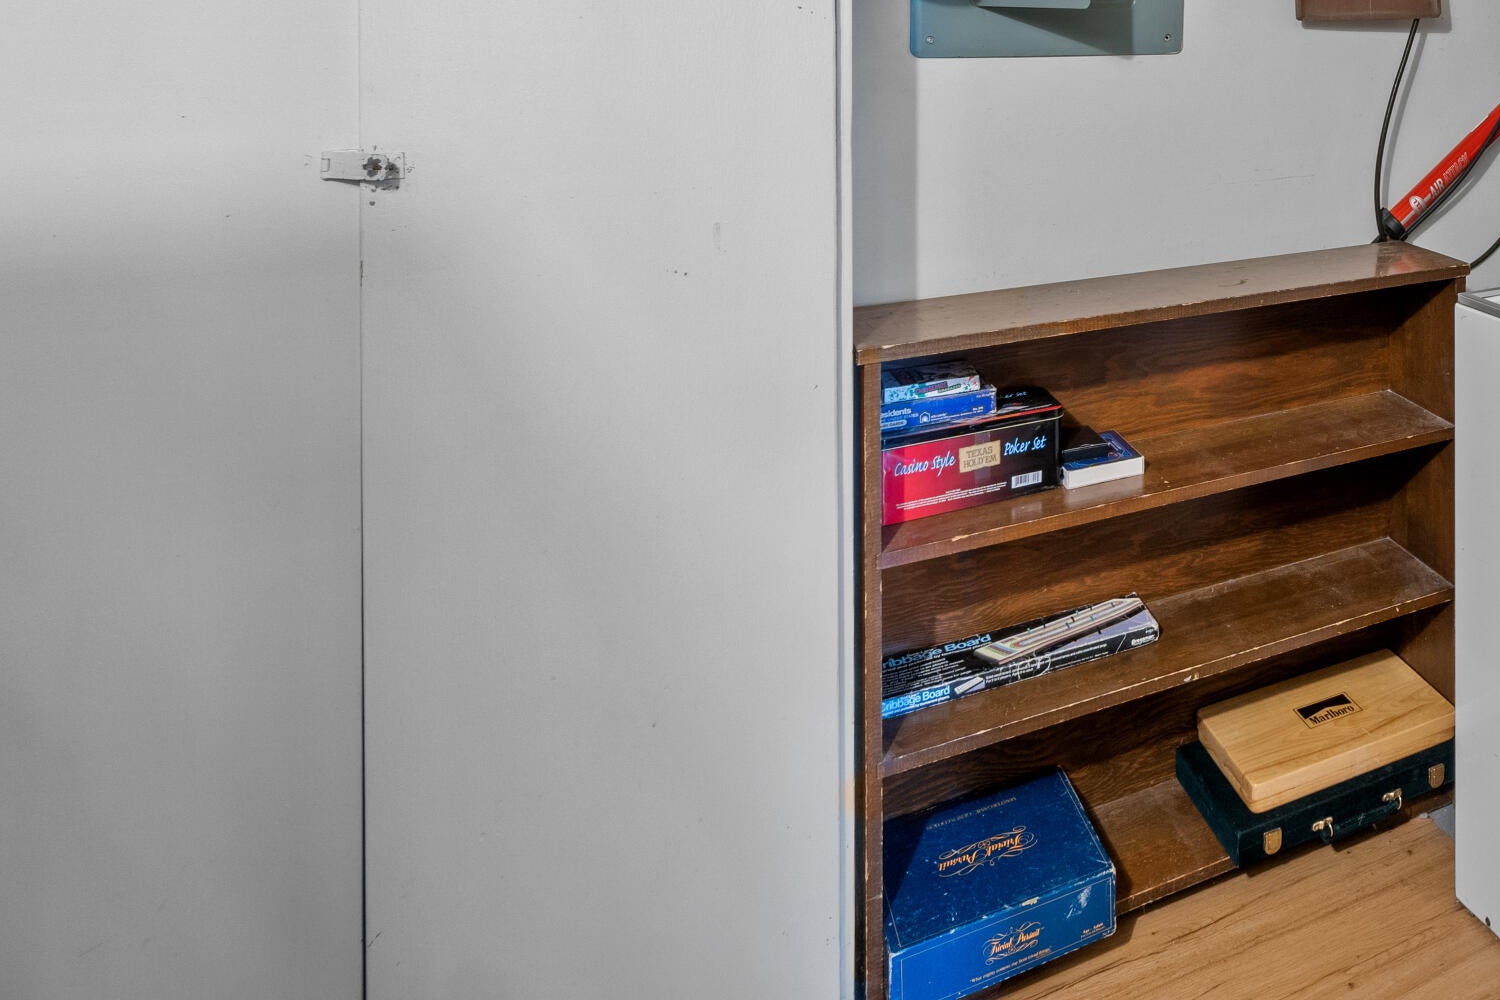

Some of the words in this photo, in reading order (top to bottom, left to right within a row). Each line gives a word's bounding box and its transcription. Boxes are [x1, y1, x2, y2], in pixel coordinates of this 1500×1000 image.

[1429, 177, 1444, 199] AIR
[966, 446, 993, 459] TEXAS
[1004, 439, 1030, 456] Poker
[1031, 435, 1047, 448] Set
[894, 461, 929, 477] Casino
[931, 452, 956, 476] Style
[963, 456, 998, 469] HOLD'EM
[944, 634, 991, 652] Board
[922, 685, 950, 701] Board
[1309, 703, 1355, 725] Marlboro
[938, 849, 979, 872] Pursuit
[990, 938, 1013, 956] Trivial
